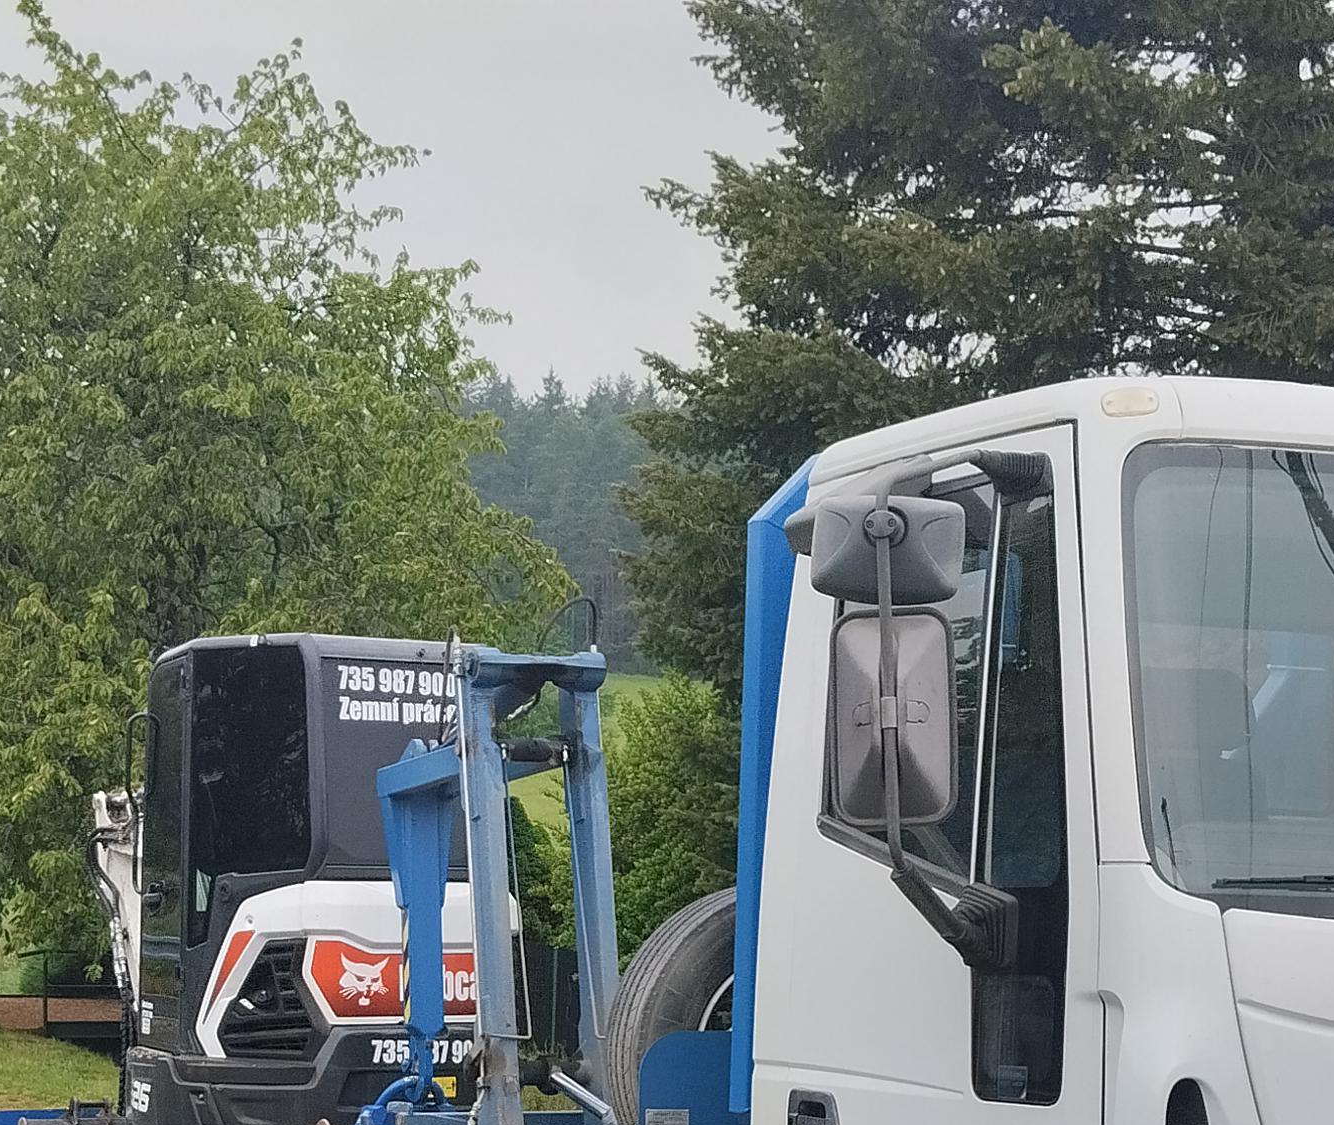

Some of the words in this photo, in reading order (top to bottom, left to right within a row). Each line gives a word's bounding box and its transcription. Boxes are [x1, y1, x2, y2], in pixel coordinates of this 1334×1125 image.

[338, 665, 375, 691] 735
[379, 668, 415, 694] 987
[418, 671, 456, 697] 900
[339, 696, 400, 721] Zemní
[371, 1040, 410, 1064] 735
